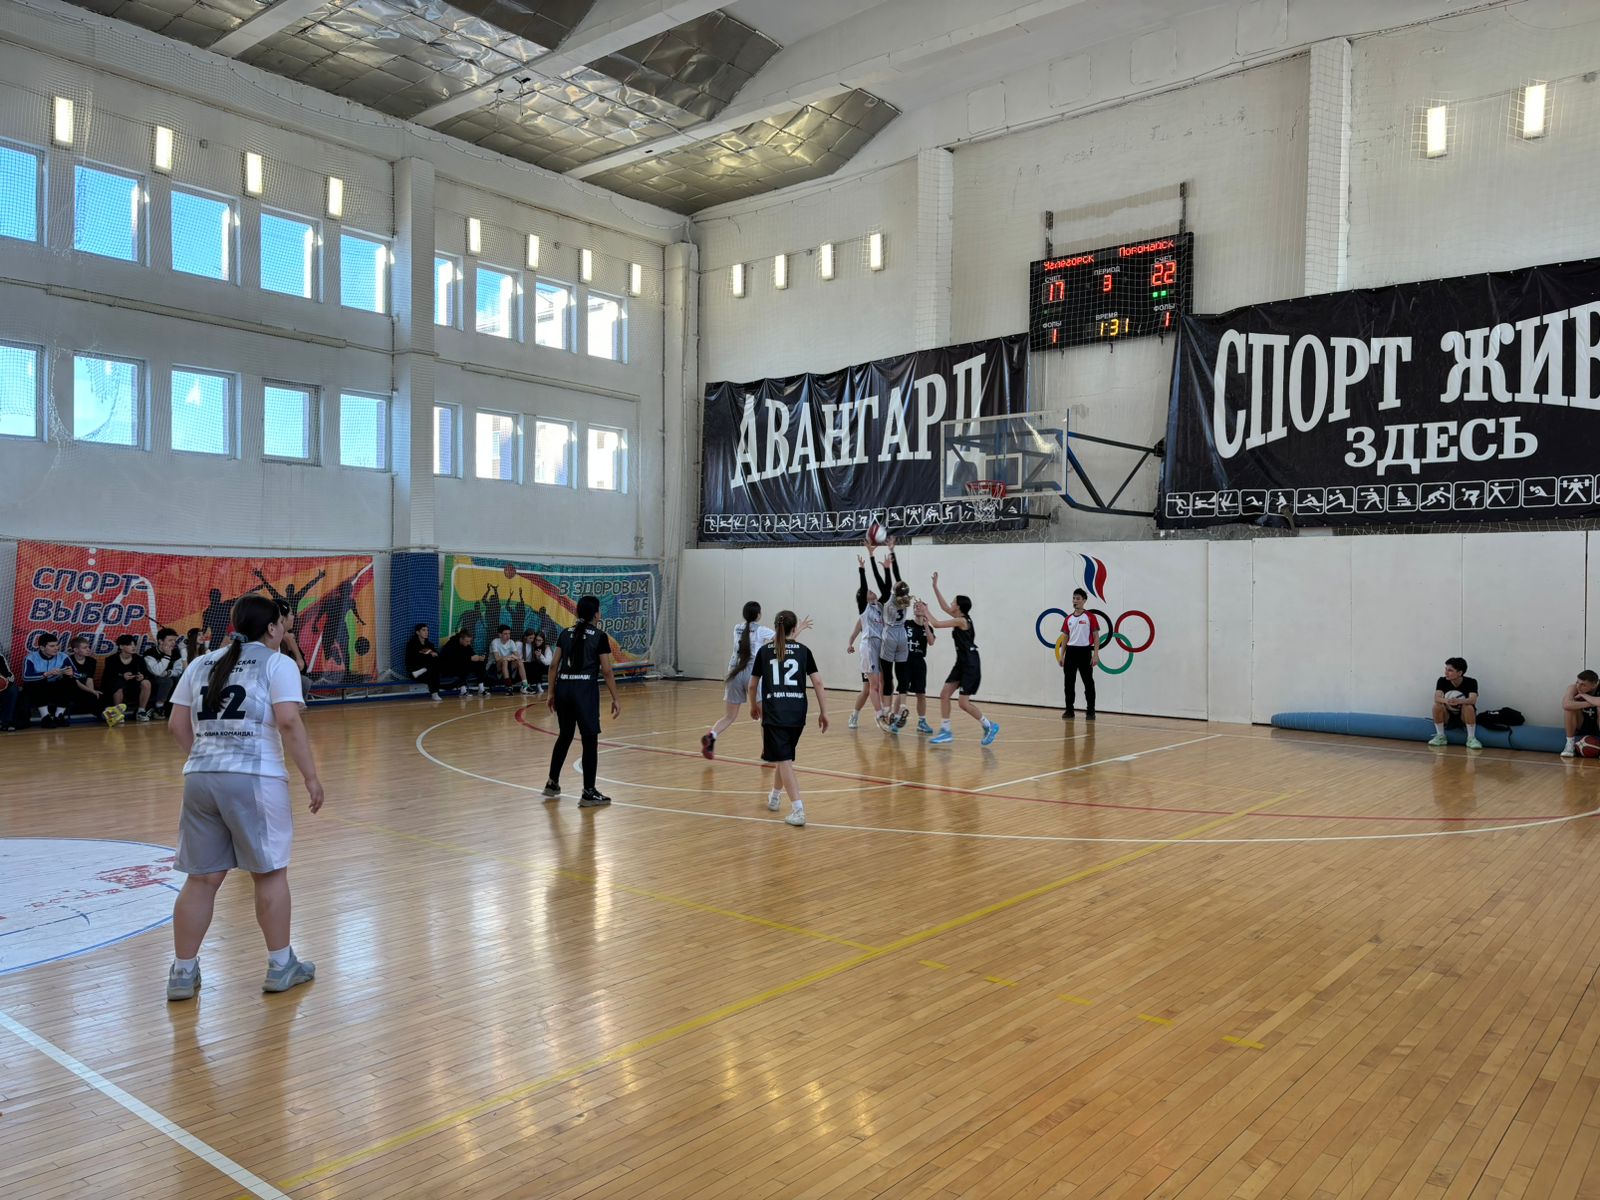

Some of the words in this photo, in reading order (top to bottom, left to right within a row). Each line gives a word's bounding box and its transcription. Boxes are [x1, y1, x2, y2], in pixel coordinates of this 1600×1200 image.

[1094, 266, 1120, 276] ПЕРИОД
[1152, 260, 1176, 286] 22
[1049, 280, 1065, 302] 17
[1103, 274, 1112, 292] 3
[1095, 311, 1118, 321] ВРЕМЯ
[1153, 303, 1176, 312] ФОЛЫ
[1042, 320, 1062, 329] ФОЛЫ
[1213, 328, 1412, 460] СПОРТ
[730, 352, 987, 490] АВАНГАРД
[1344, 415, 1538, 476] ЗДЕСЬ
[573, 579, 649, 596] ЗДОРОВОМ
[29, 597, 146, 626] ВЫБОР
[619, 598, 649, 613] ТЕЛЕ
[769, 658, 799, 686] 12
[197, 684, 247, 721] 12
